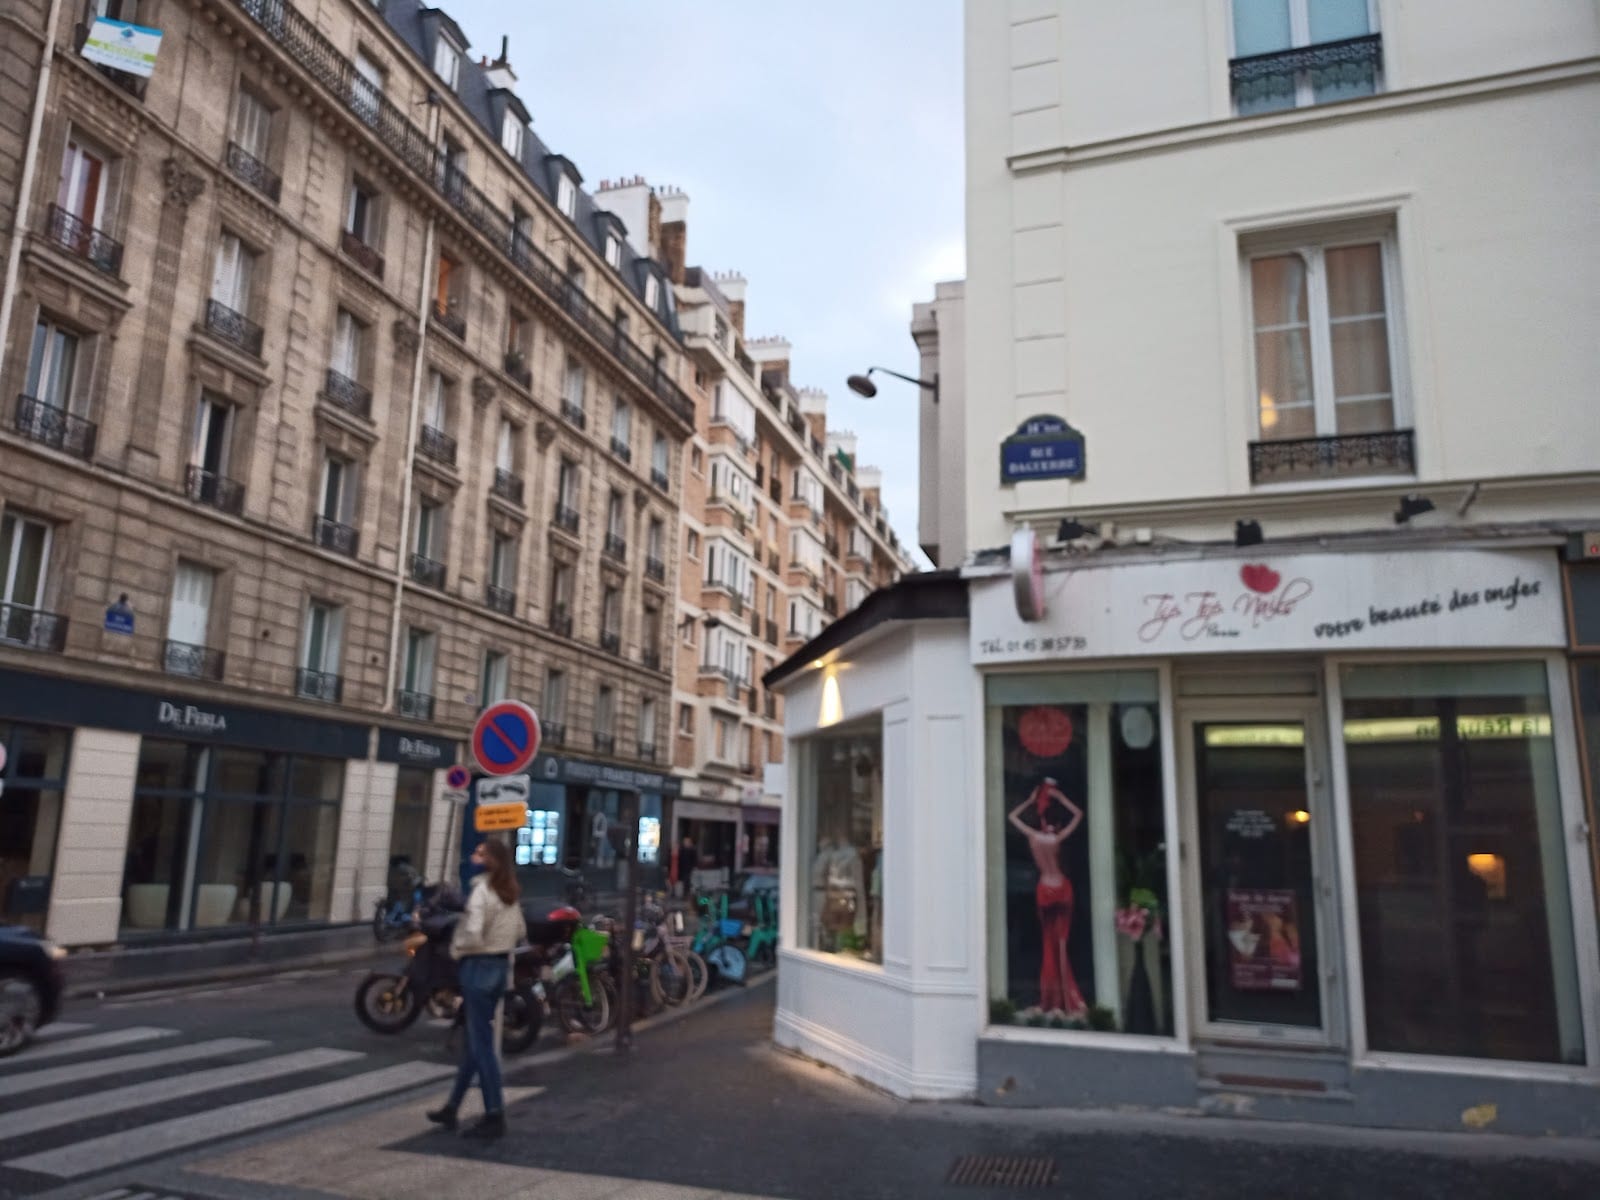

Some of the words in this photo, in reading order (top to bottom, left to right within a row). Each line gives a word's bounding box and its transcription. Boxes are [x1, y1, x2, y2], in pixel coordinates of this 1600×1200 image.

[1314, 619, 1364, 638] votre
[1369, 595, 1442, 626] beauté
[1449, 590, 1480, 612] des
[1484, 576, 1542, 610] ongles
